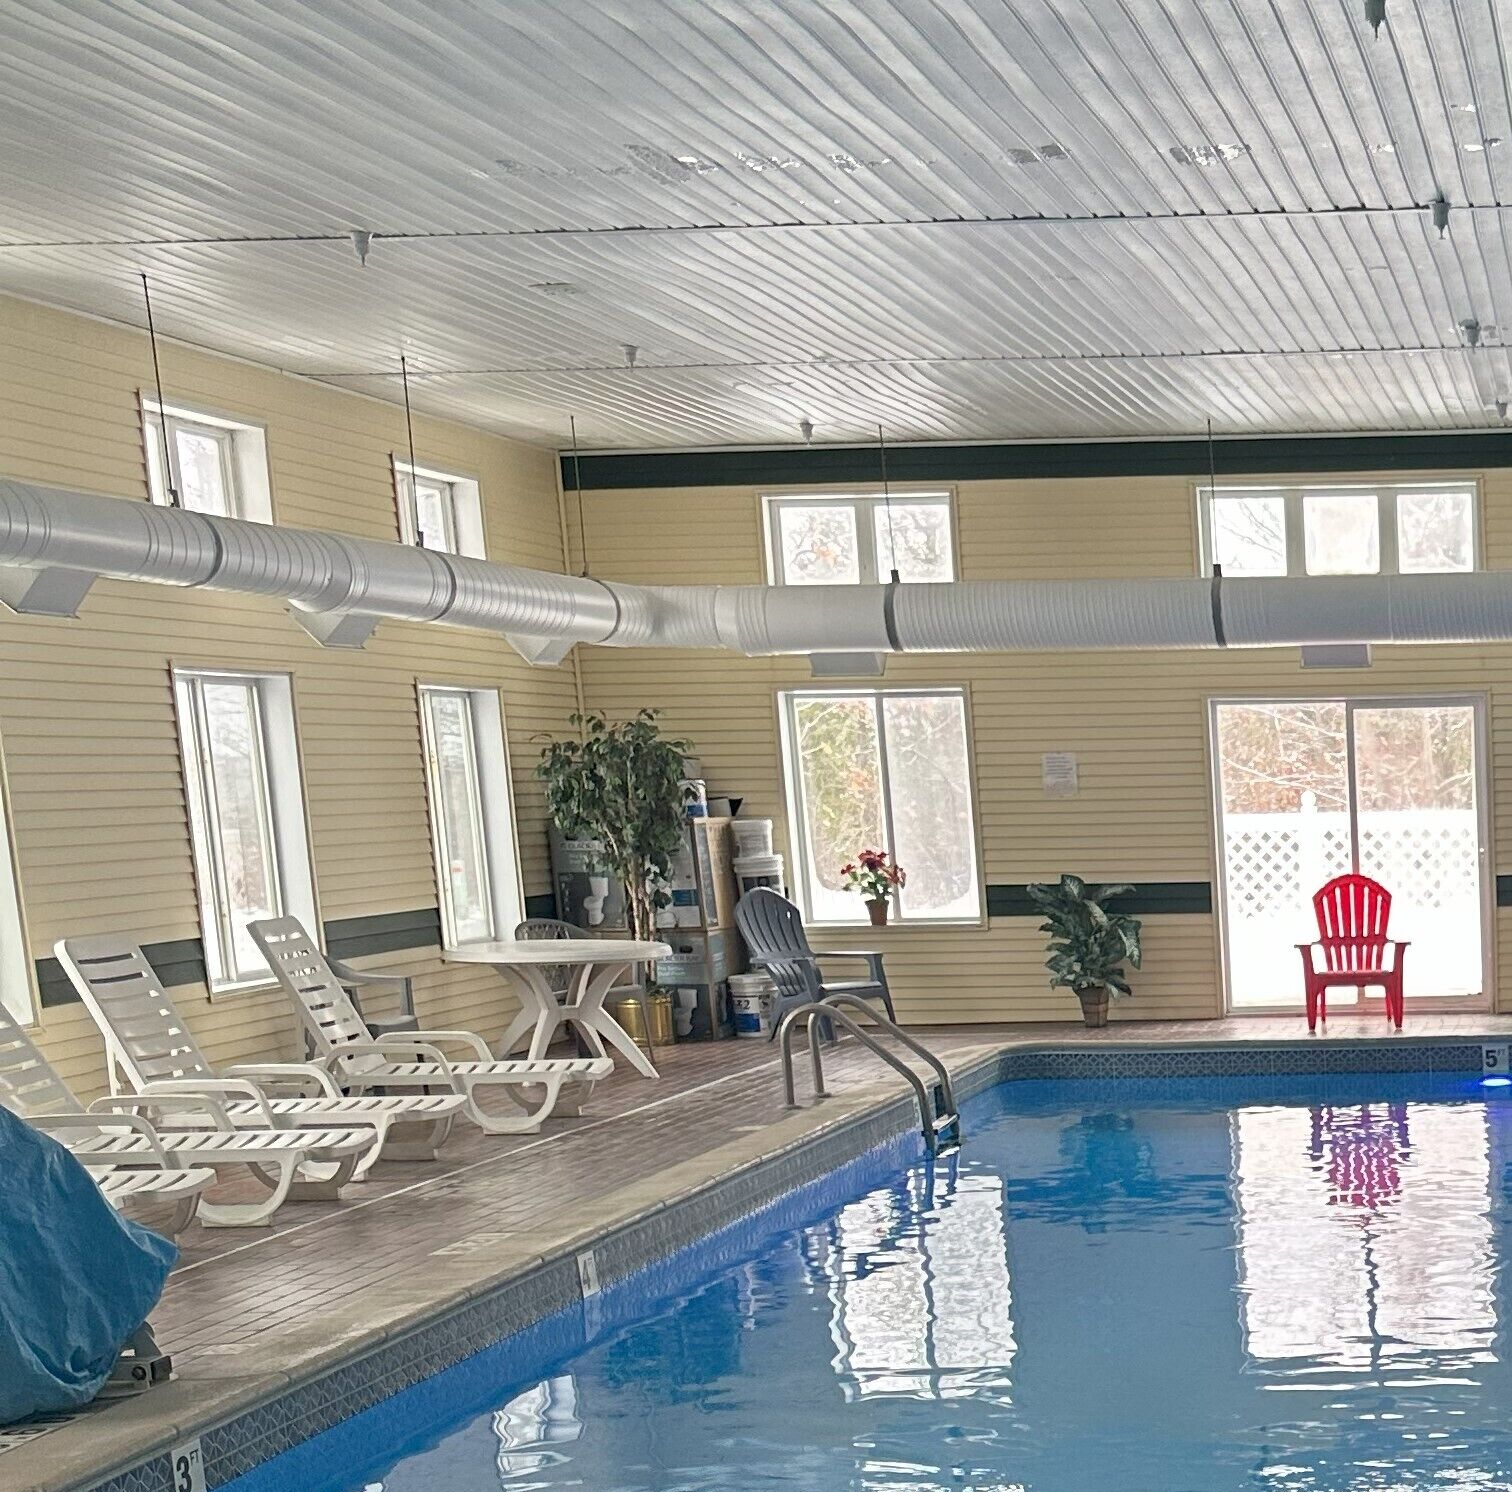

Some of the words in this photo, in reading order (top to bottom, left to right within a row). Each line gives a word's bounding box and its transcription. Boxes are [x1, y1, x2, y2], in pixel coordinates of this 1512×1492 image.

[1485, 1049, 1498, 1068] 5
[583, 1259, 591, 1290] 4
[189, 1448, 199, 1466] FT
